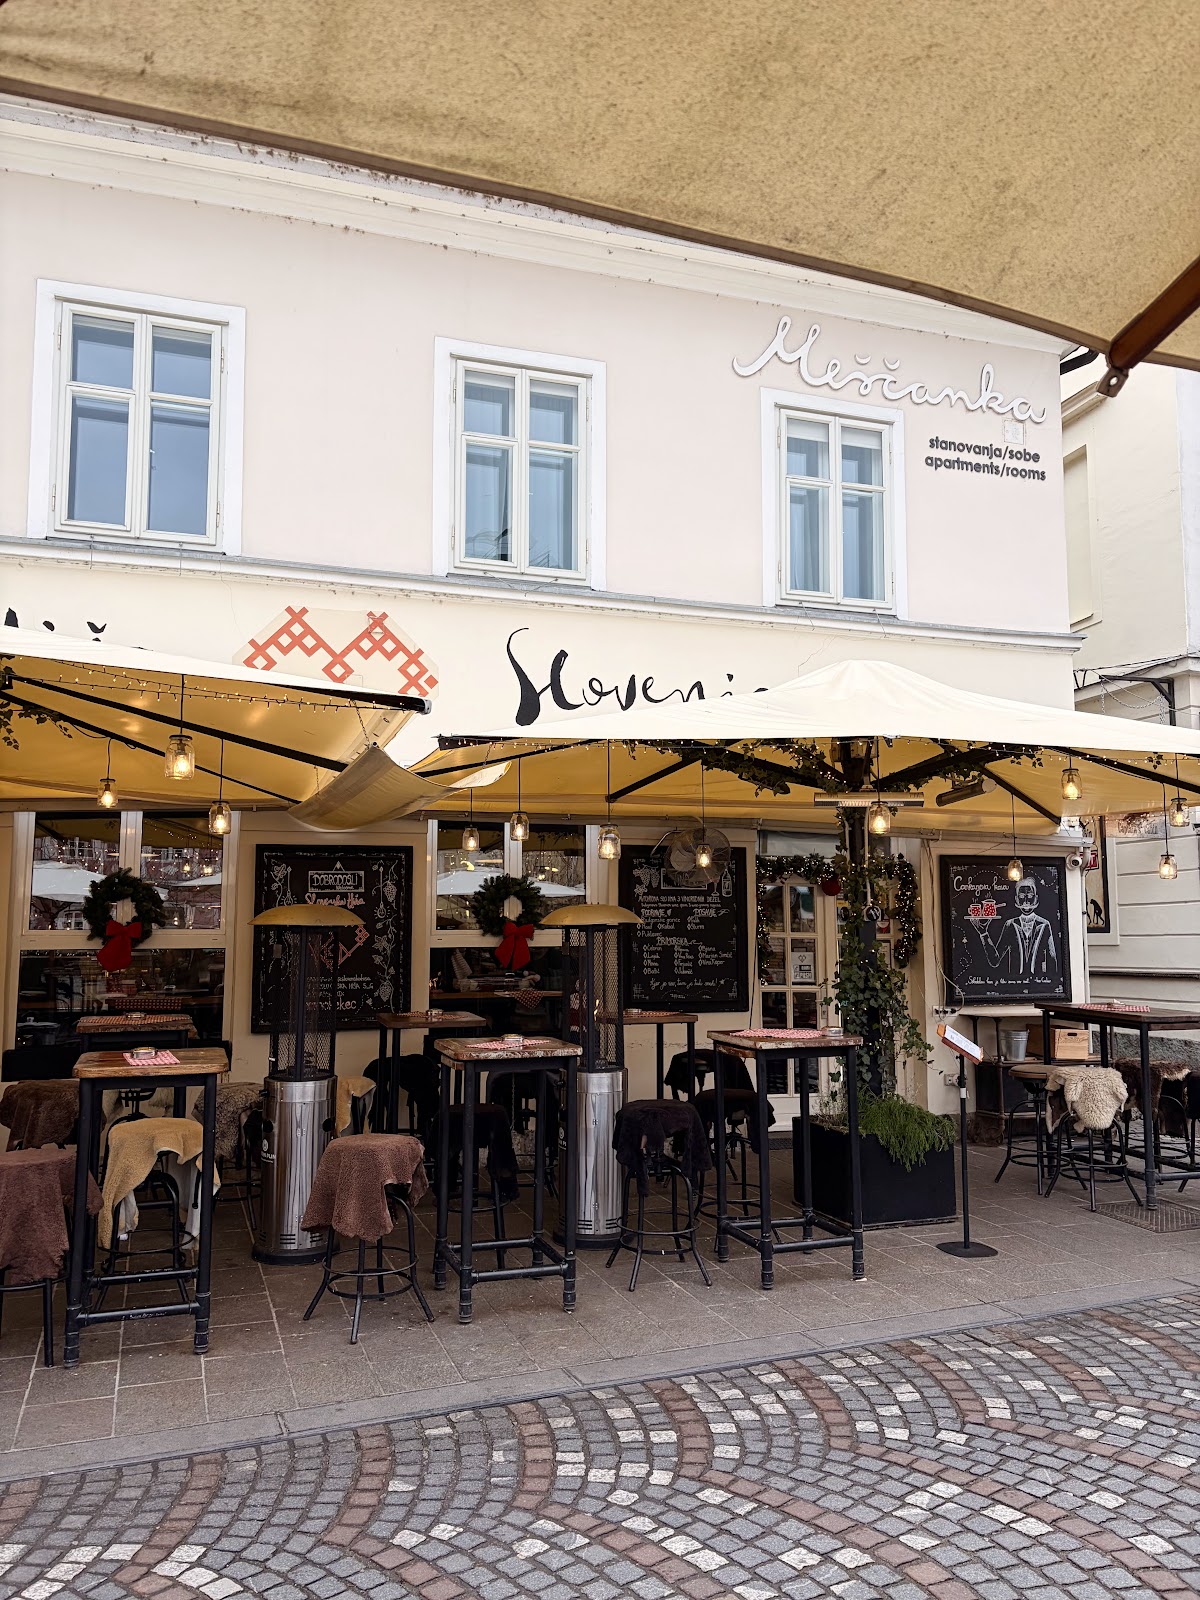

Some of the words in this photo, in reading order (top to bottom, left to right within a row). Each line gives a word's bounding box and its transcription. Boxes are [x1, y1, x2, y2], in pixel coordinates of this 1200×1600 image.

[732, 315, 1048, 425] Meščanka
[924, 455, 1047, 481] apartments/rooms
[928, 436, 1041, 463] stanovanja/sobe
[506, 627, 770, 727] Sloven
